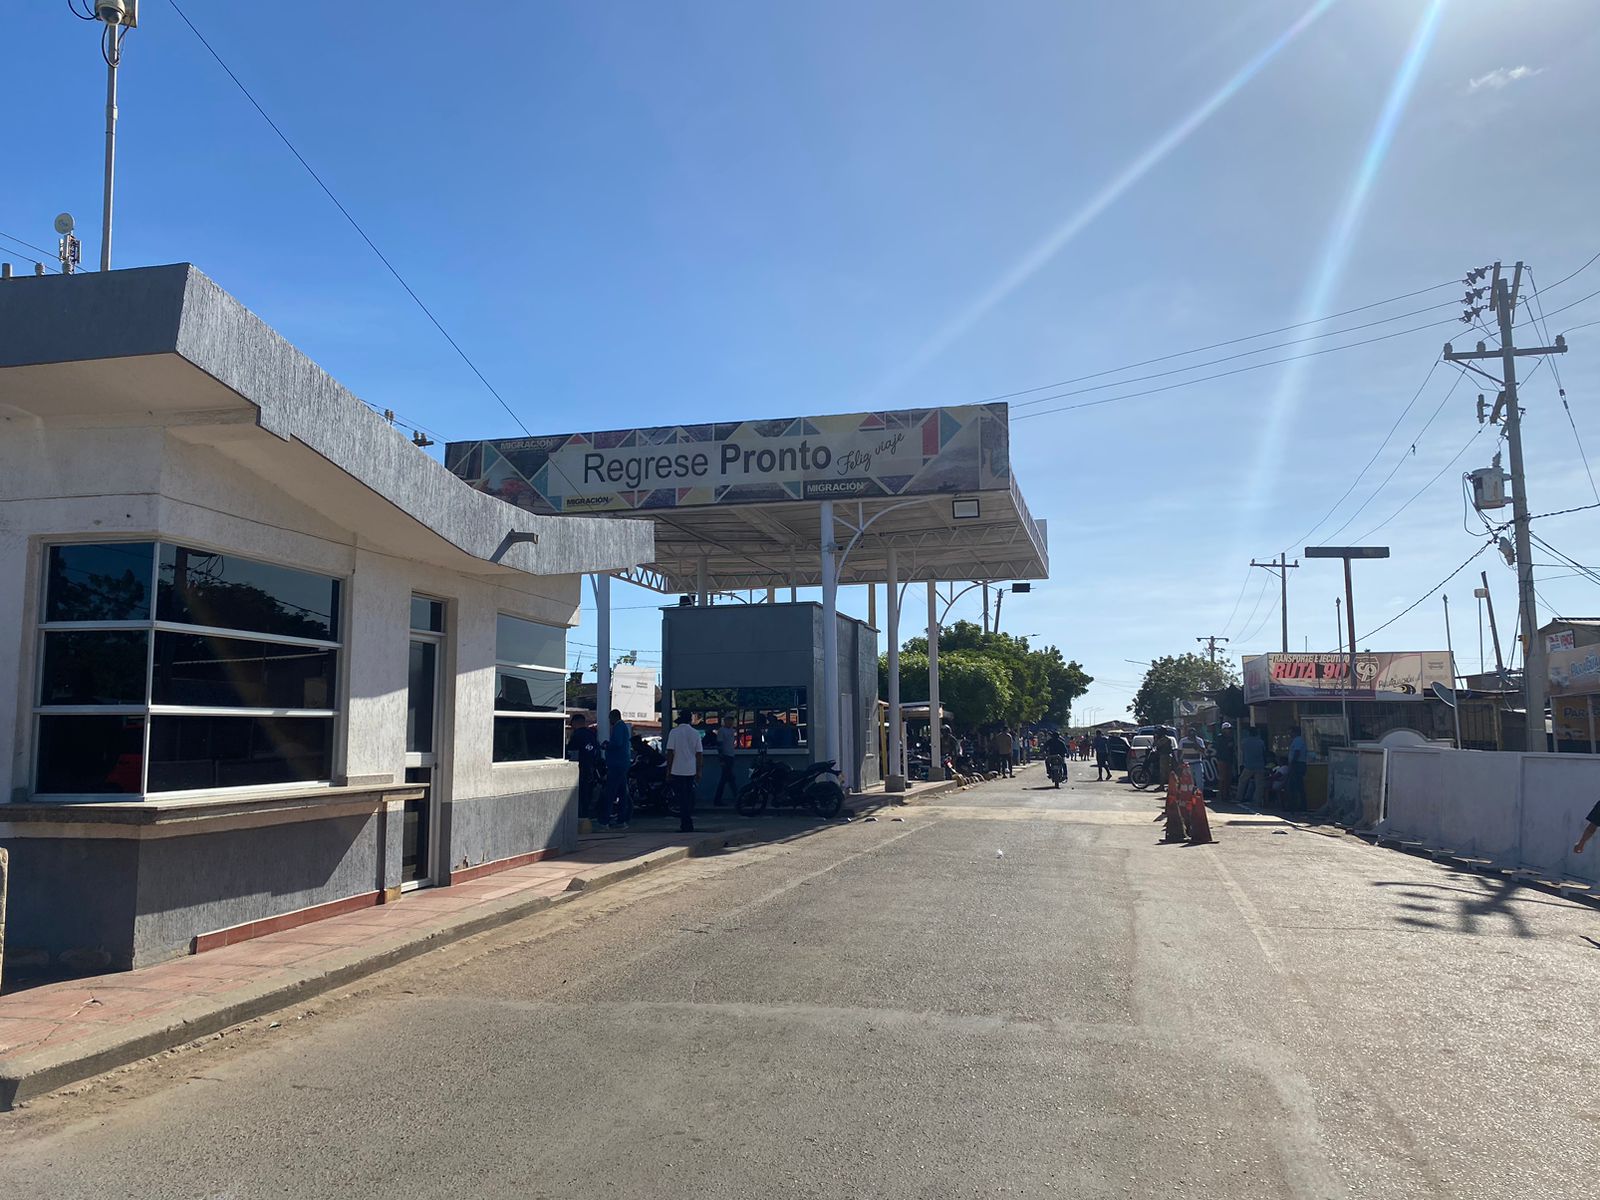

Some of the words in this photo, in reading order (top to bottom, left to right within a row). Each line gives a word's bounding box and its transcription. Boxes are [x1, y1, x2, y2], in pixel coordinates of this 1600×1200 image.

[874, 431, 905, 455] viaje
[583, 451, 709, 489] Regrese
[720, 440, 832, 475] Pronto
[807, 480, 864, 493] MIGRACIÓN
[1272, 654, 1313, 663] TRANSPORTE
[1272, 663, 1316, 679] RUTA
[1323, 662, 1347, 679] 90
